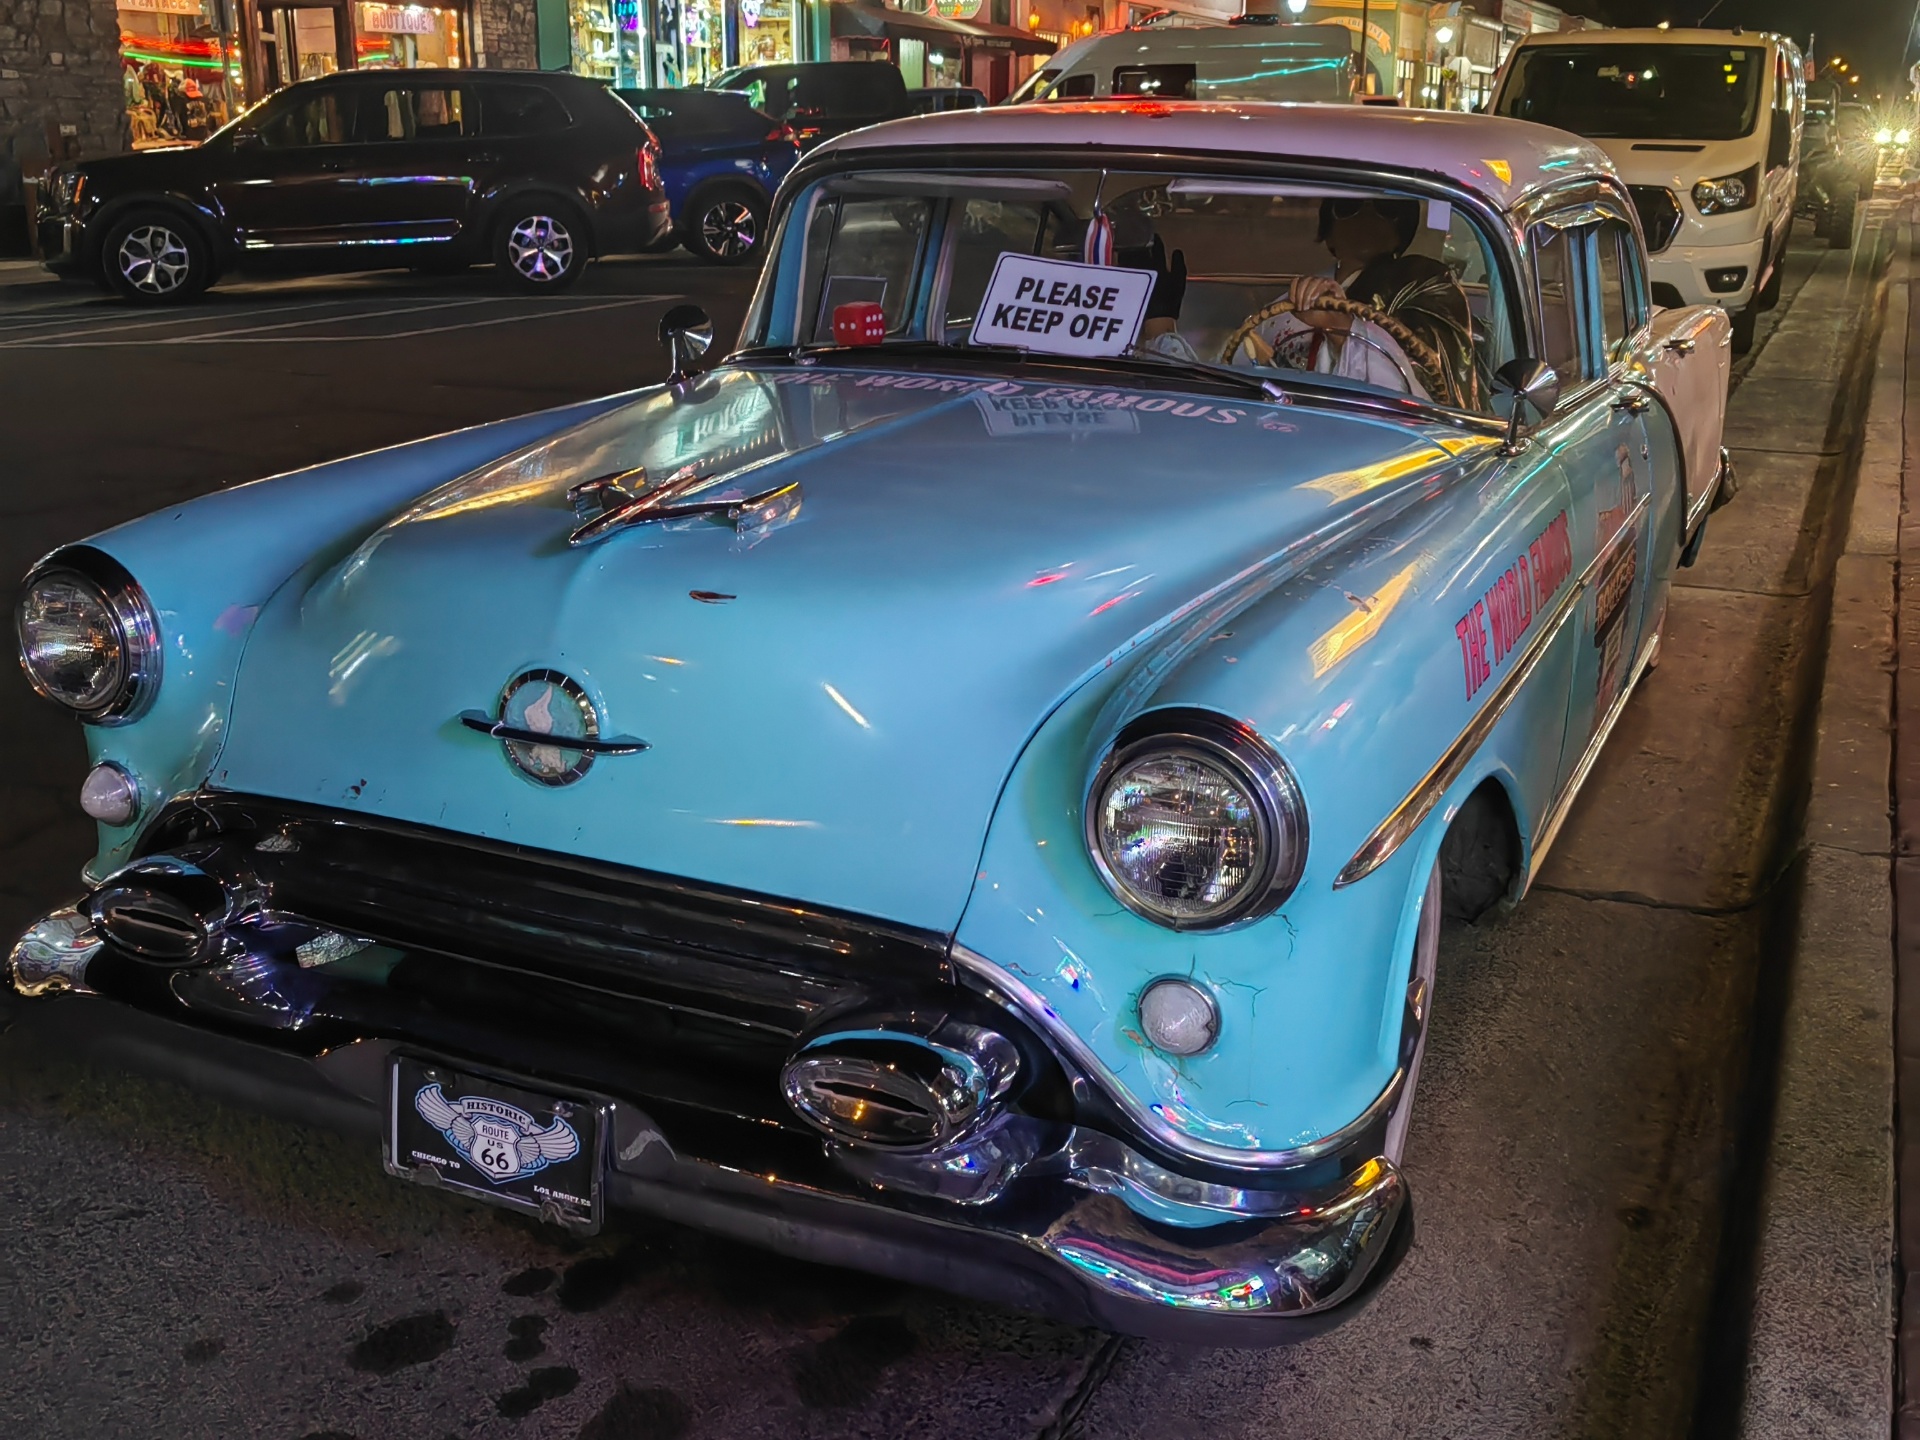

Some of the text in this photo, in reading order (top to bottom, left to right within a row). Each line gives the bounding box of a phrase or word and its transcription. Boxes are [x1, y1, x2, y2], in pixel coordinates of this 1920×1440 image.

[372, 11, 428, 31] BOUTIQUE
[1015, 277, 1120, 311] PLEASE
[991, 303, 1123, 342] KEEP OFF
[1031, 388, 1247, 424] FAMOUS
[1455, 599, 1491, 702] THE
[1485, 554, 1532, 667] WORLD
[466, 1101, 527, 1125] HISTORIC
[482, 1124, 509, 1140] ROUTE
[487, 1139, 504, 1149] US
[412, 1150, 461, 1169] CHICAGO TO
[481, 1148, 509, 1170] 66
[533, 1185, 592, 1207] LOS ANGELES
